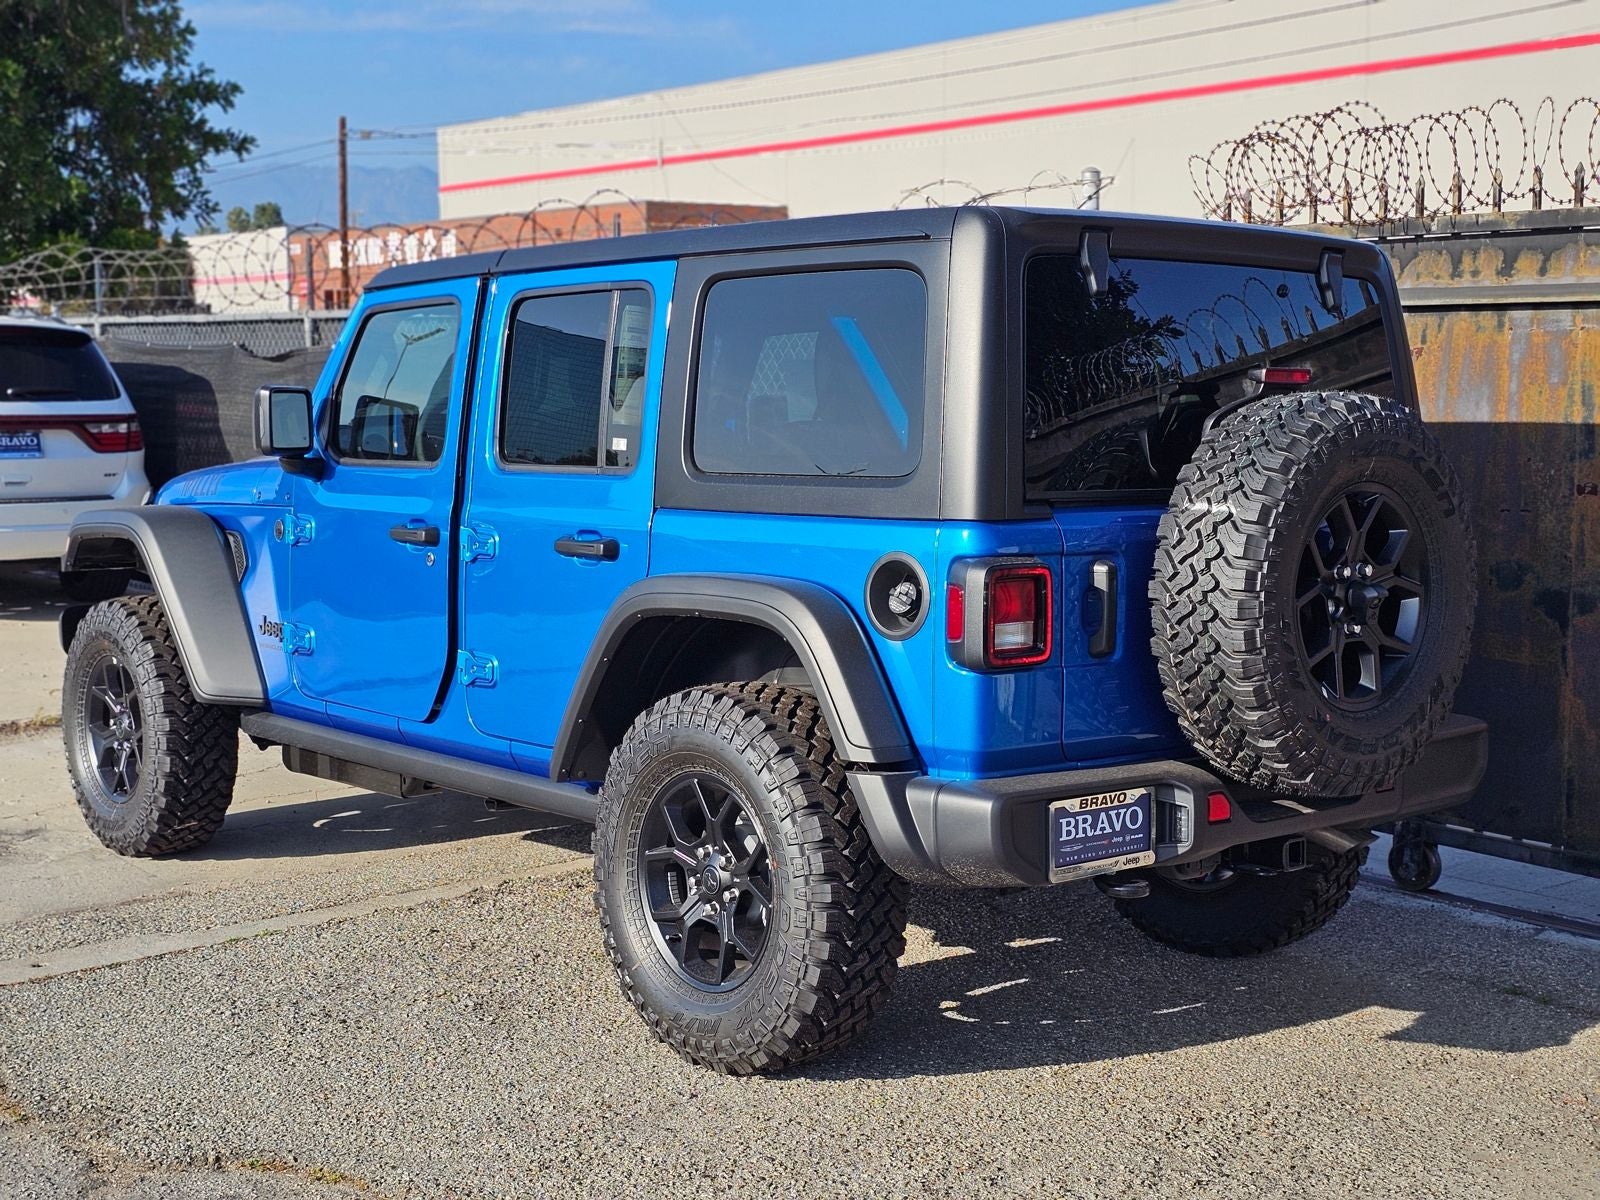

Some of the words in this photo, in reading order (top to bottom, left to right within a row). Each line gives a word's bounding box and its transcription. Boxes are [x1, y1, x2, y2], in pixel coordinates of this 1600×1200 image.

[1078, 792, 1128, 810] BRAVO
[1059, 806, 1144, 841] BRAVO
[1122, 856, 1140, 866] Jeep
